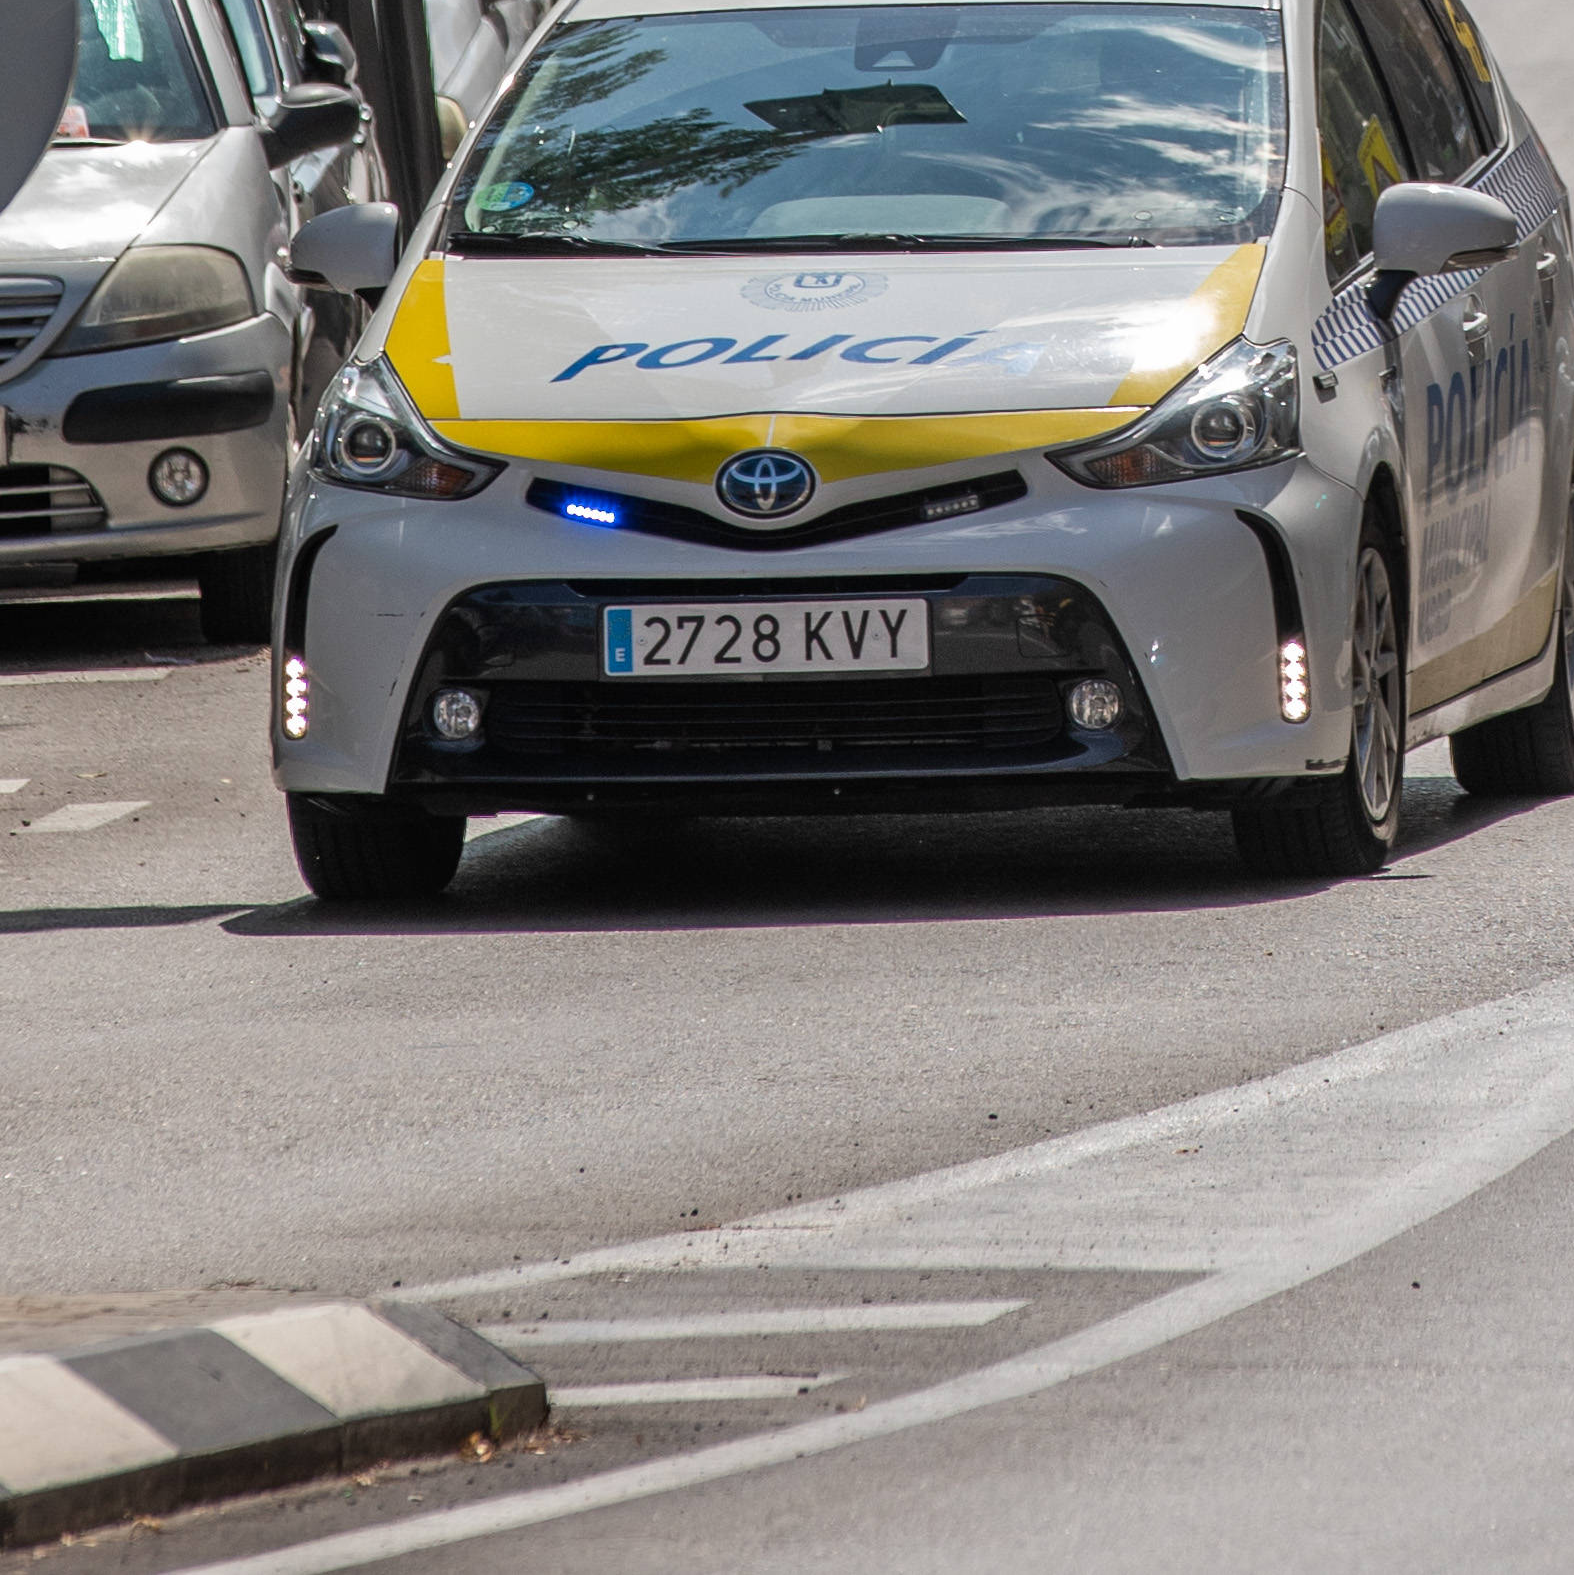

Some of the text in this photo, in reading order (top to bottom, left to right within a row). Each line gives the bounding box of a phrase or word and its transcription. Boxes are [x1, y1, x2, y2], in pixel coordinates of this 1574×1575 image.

[1425, 312, 1531, 518] POLICÍA
[614, 647, 626, 663] E
[643, 608, 907, 666] 2728 KVY
